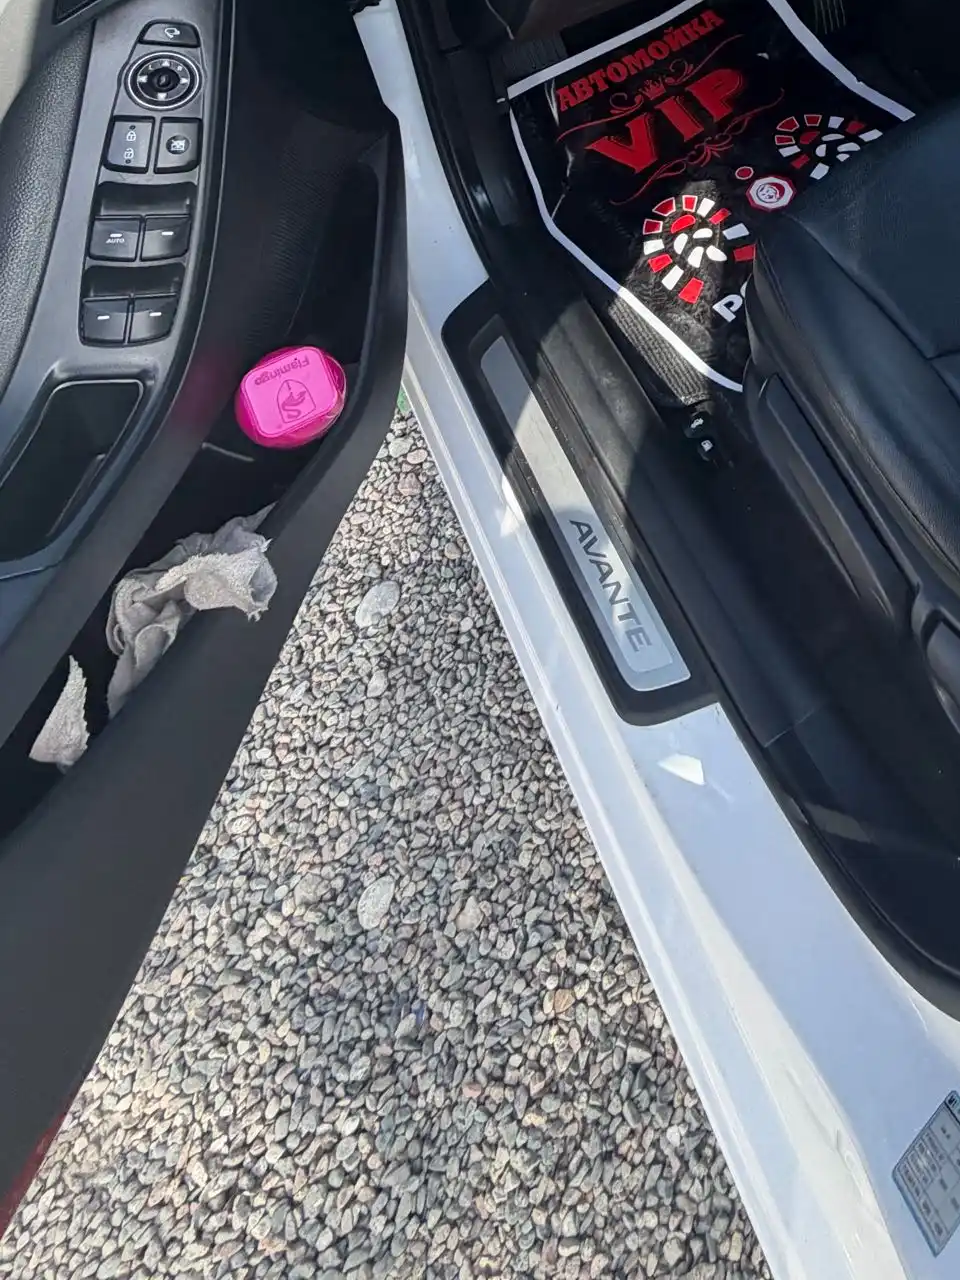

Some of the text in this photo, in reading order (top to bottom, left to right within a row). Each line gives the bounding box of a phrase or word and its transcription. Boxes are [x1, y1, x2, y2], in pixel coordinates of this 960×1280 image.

[555, 8, 726, 112] АВТОМОЙКА
[584, 67, 748, 174] VIP
[254, 355, 310, 386] Flamingo
[568, 519, 652, 652] AVANTE
